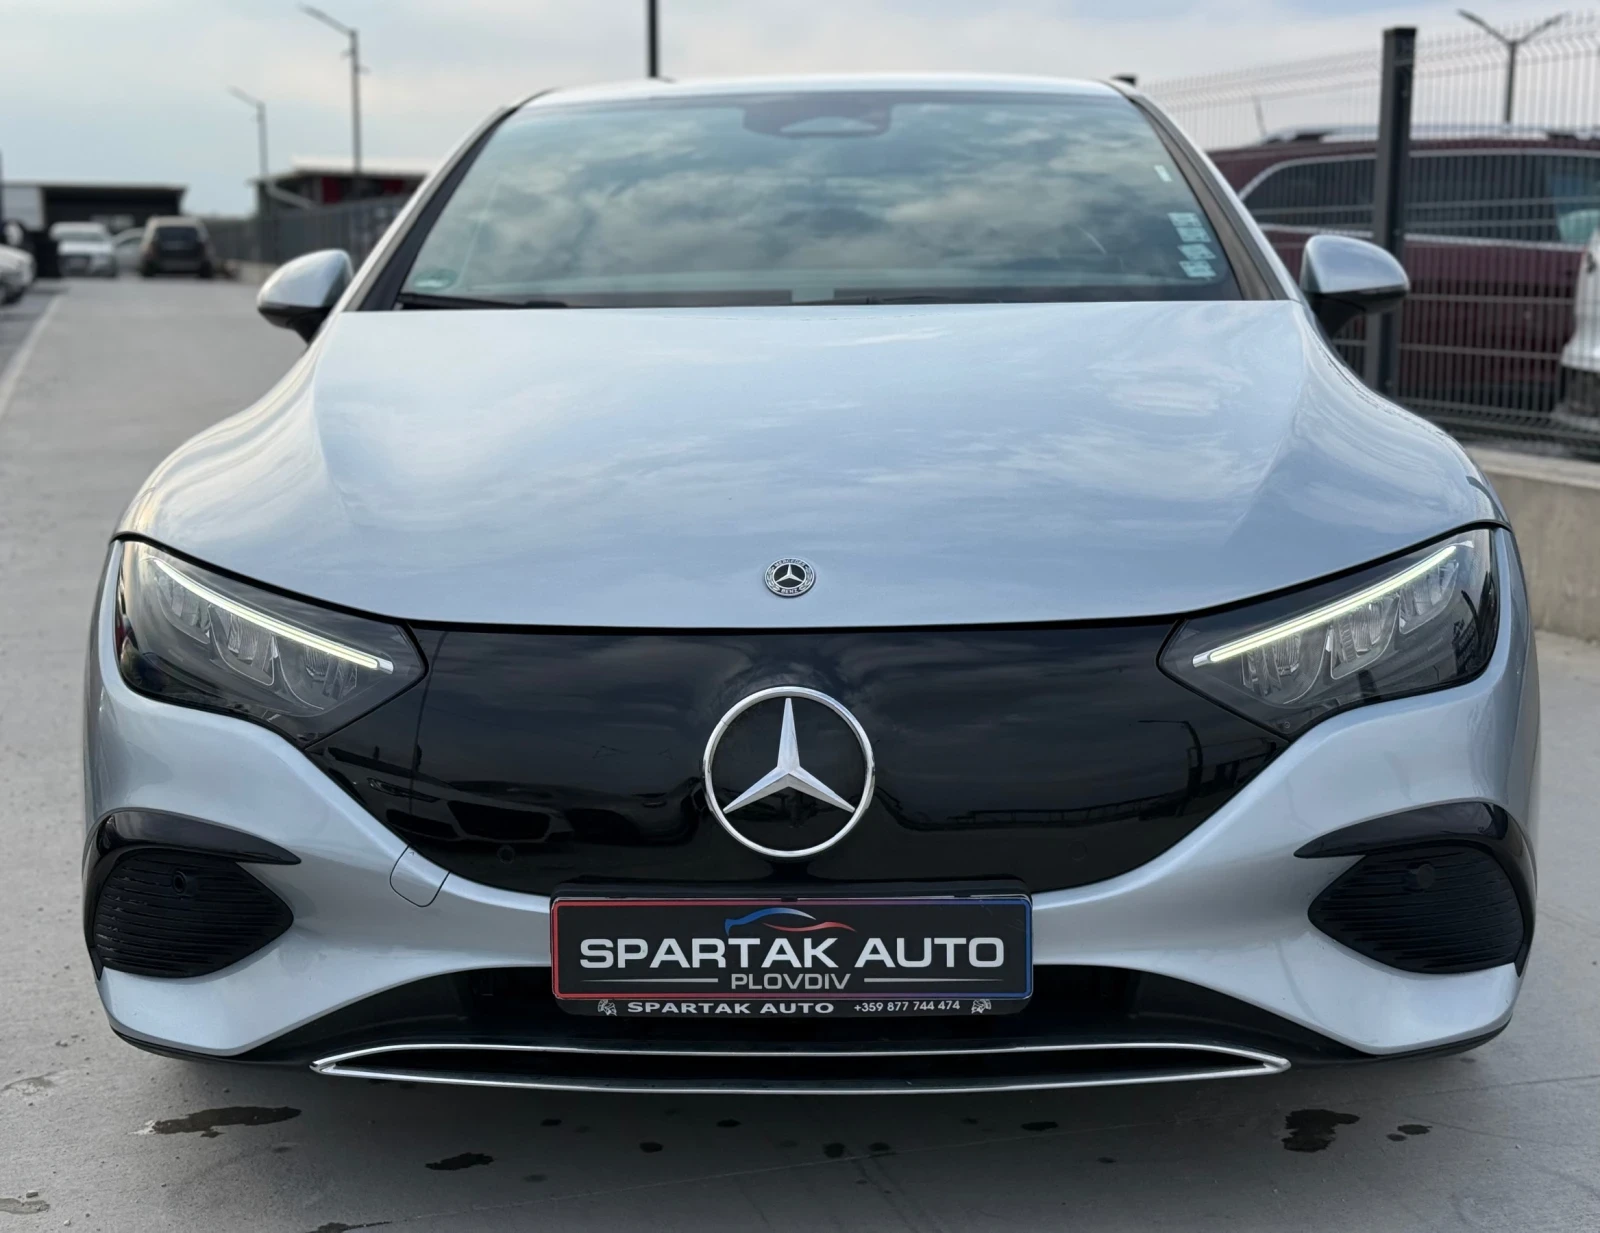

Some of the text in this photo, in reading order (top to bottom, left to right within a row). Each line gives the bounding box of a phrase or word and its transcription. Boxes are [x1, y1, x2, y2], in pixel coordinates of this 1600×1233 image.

[580, 937, 1005, 969] SPARTAK AUTO
[731, 973, 851, 990] PLOVDIV
[627, 1001, 834, 1014] SPARTAK AUTO
[854, 1000, 961, 1012] +359 877 744 474
